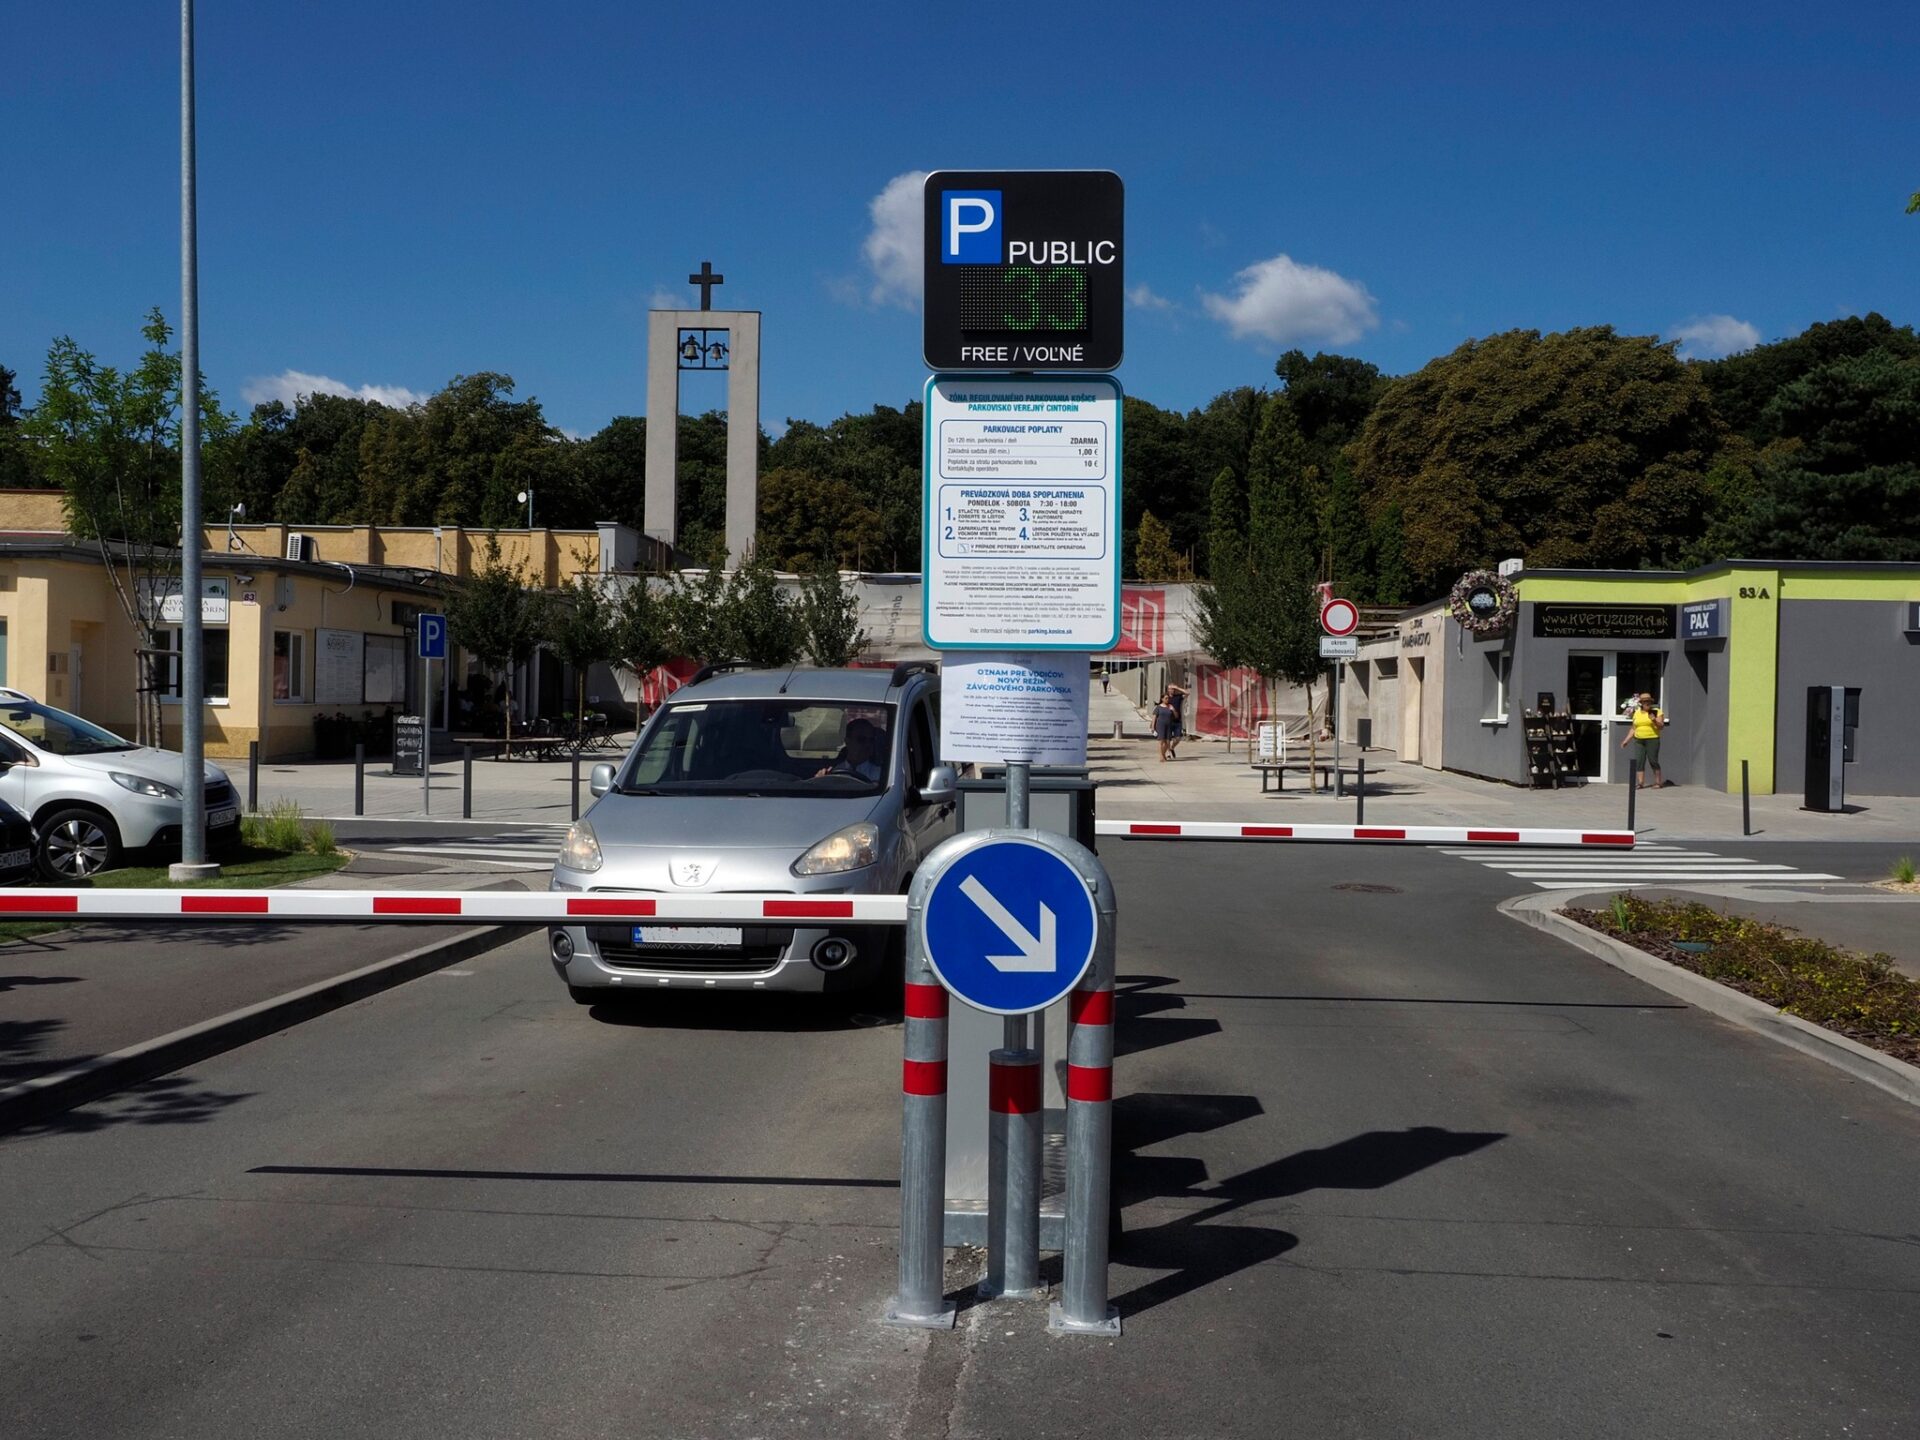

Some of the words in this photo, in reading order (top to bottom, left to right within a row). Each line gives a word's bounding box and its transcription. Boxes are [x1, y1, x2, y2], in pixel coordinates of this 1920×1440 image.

[950, 198, 994, 256] P
[1009, 241, 1115, 264] PUBLIC
[1004, 267, 1083, 330] 33
[962, 347, 1007, 361] FREE
[1024, 344, 1083, 361] VOĽNÉ
[961, 489, 1010, 498] PREVÁDZKOVÁ
[946, 508, 956, 520] 1.
[1019, 508, 1030, 521] 3.
[945, 527, 956, 540] 2.
[1019, 527, 1030, 540] 4.
[1690, 612, 1709, 630] PAX
[426, 620, 440, 652] P
